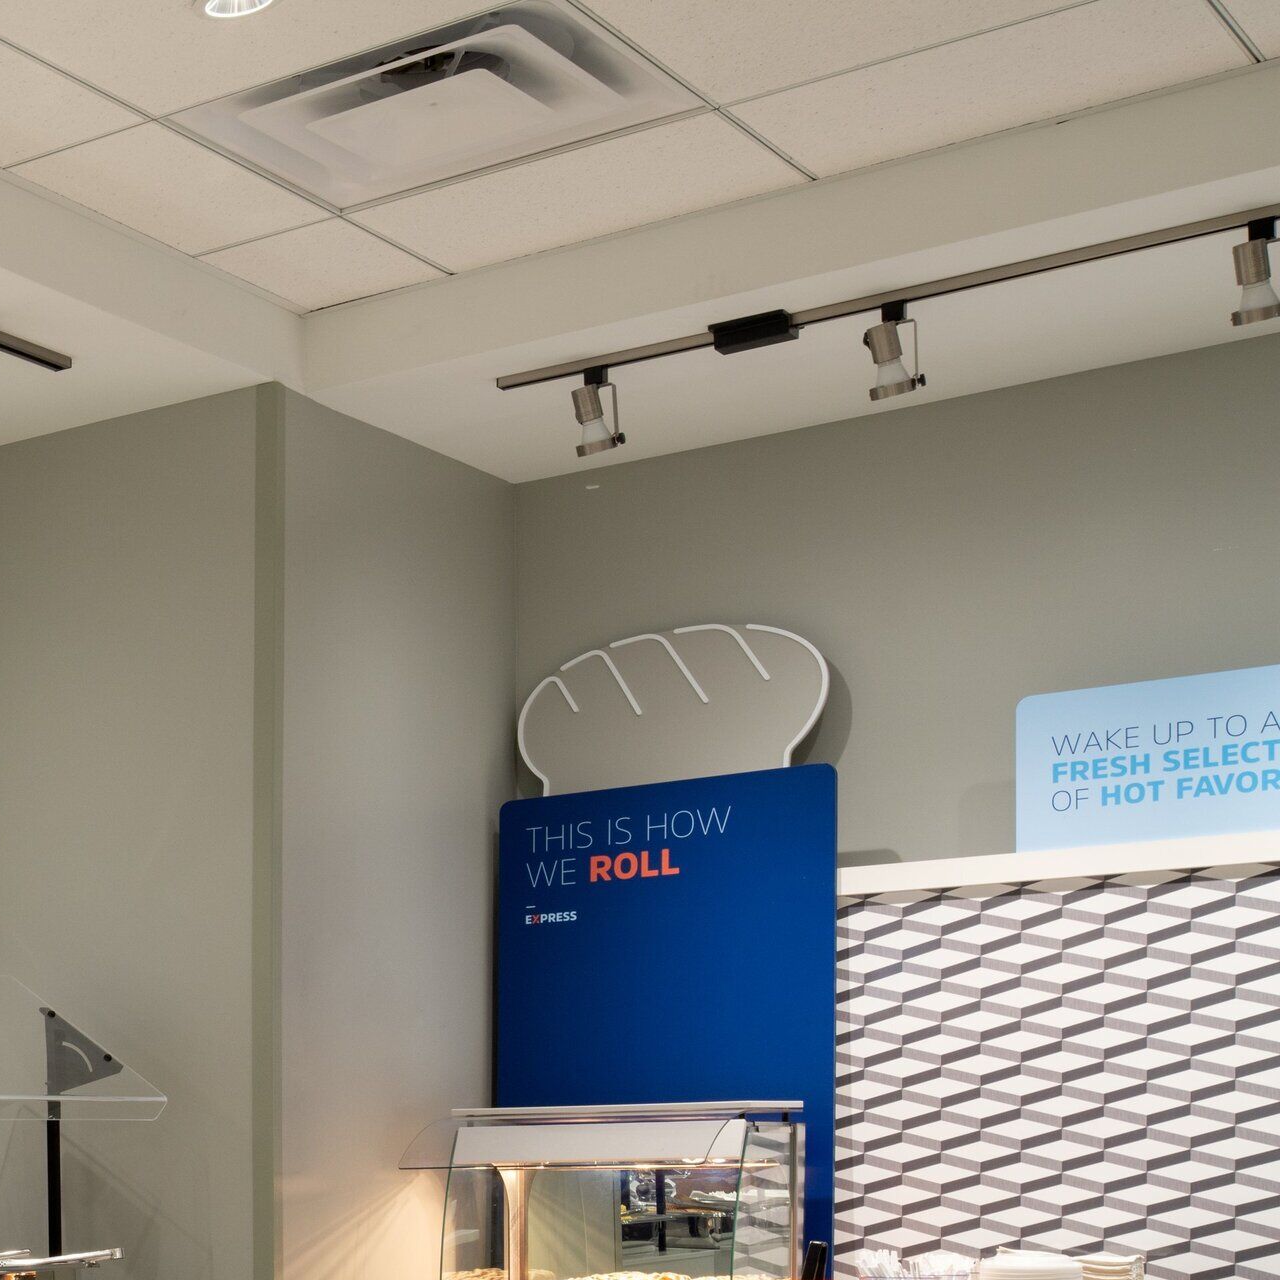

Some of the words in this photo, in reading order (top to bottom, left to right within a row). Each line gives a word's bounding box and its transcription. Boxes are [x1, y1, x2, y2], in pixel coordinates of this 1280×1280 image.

[1051, 726, 1139, 756] WAKE
[1153, 720, 1194, 746] UP
[1206, 714, 1248, 739] TO
[1260, 710, 1280, 734] A
[1052, 753, 1151, 784] FRESH
[1163, 738, 1280, 772] SELECT
[1051, 788, 1089, 812] OF
[1101, 780, 1165, 806] HOT
[1176, 768, 1280, 800] FAVOR
[526, 821, 594, 853] THIS
[607, 816, 632, 846] IS
[646, 805, 732, 841] HOW
[526, 858, 577, 888] WE
[589, 848, 680, 882] ROLL
[525, 911, 577, 925] EXPRESS
